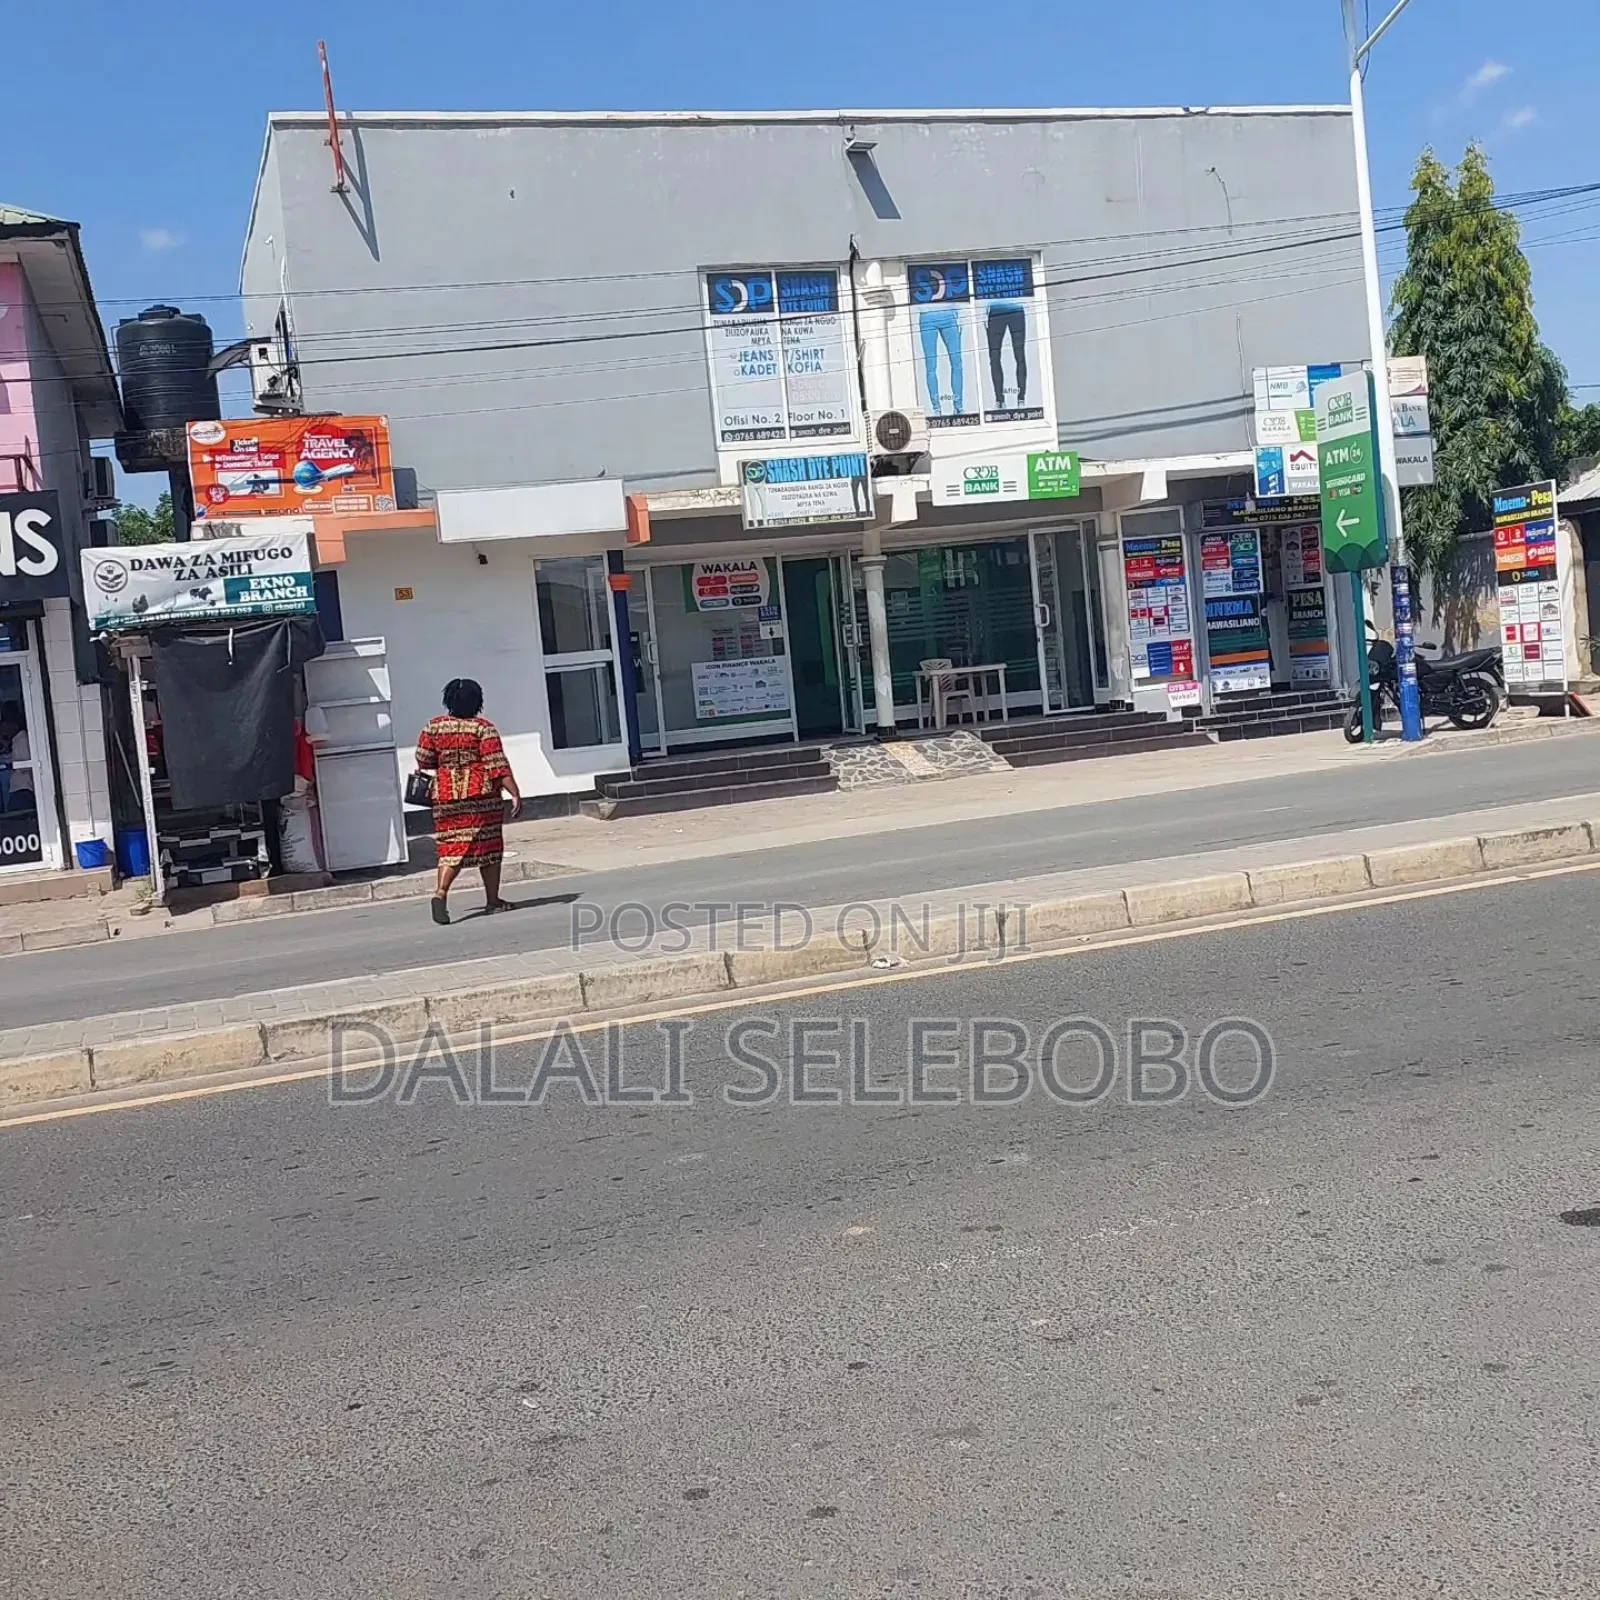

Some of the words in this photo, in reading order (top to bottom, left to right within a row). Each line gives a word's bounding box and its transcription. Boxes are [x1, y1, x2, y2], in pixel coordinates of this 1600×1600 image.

[738, 350, 774, 363] JEANS
[786, 348, 825, 362] T/SHIRT
[740, 362, 777, 376] KADET
[787, 361, 823, 374] KOFIA
[1270, 381, 1289, 390] NMB
[724, 415, 749, 427] Ofisi
[751, 414, 771, 424] No.
[788, 412, 815, 422] Floor
[818, 410, 837, 420] No.
[840, 408, 846, 418] 1
[1328, 410, 1353, 426] BANK
[756, 430, 785, 440] 689425
[302, 438, 349, 449] TRAVEL
[300, 447, 356, 460] AGENCY
[1325, 446, 1349, 467] ATM
[1352, 448, 1361, 457] 24
[1395, 455, 1429, 465] WAKALA
[766, 458, 807, 483] SMASH
[808, 456, 831, 480] DYE
[831, 453, 866, 479] POINT
[1034, 456, 1072, 473] ATM
[965, 482, 999, 494] BANK
[129, 557, 189, 572] DAWA
[189, 553, 217, 567] ZA
[221, 546, 293, 565] MIFUGO
[174, 567, 204, 582] ZA
[205, 562, 254, 579] ASILI
[701, 560, 758, 574] WAKALA
[248, 576, 296, 590] EKNO
[238, 586, 309, 602] BRANCH
[1292, 590, 1323, 607] PESA
[1292, 609, 1323, 620] BRANCH
[705, 662, 721, 670] ICON
[749, 658, 777, 667] WAKALA
[0, 833, 40, 855] 000
